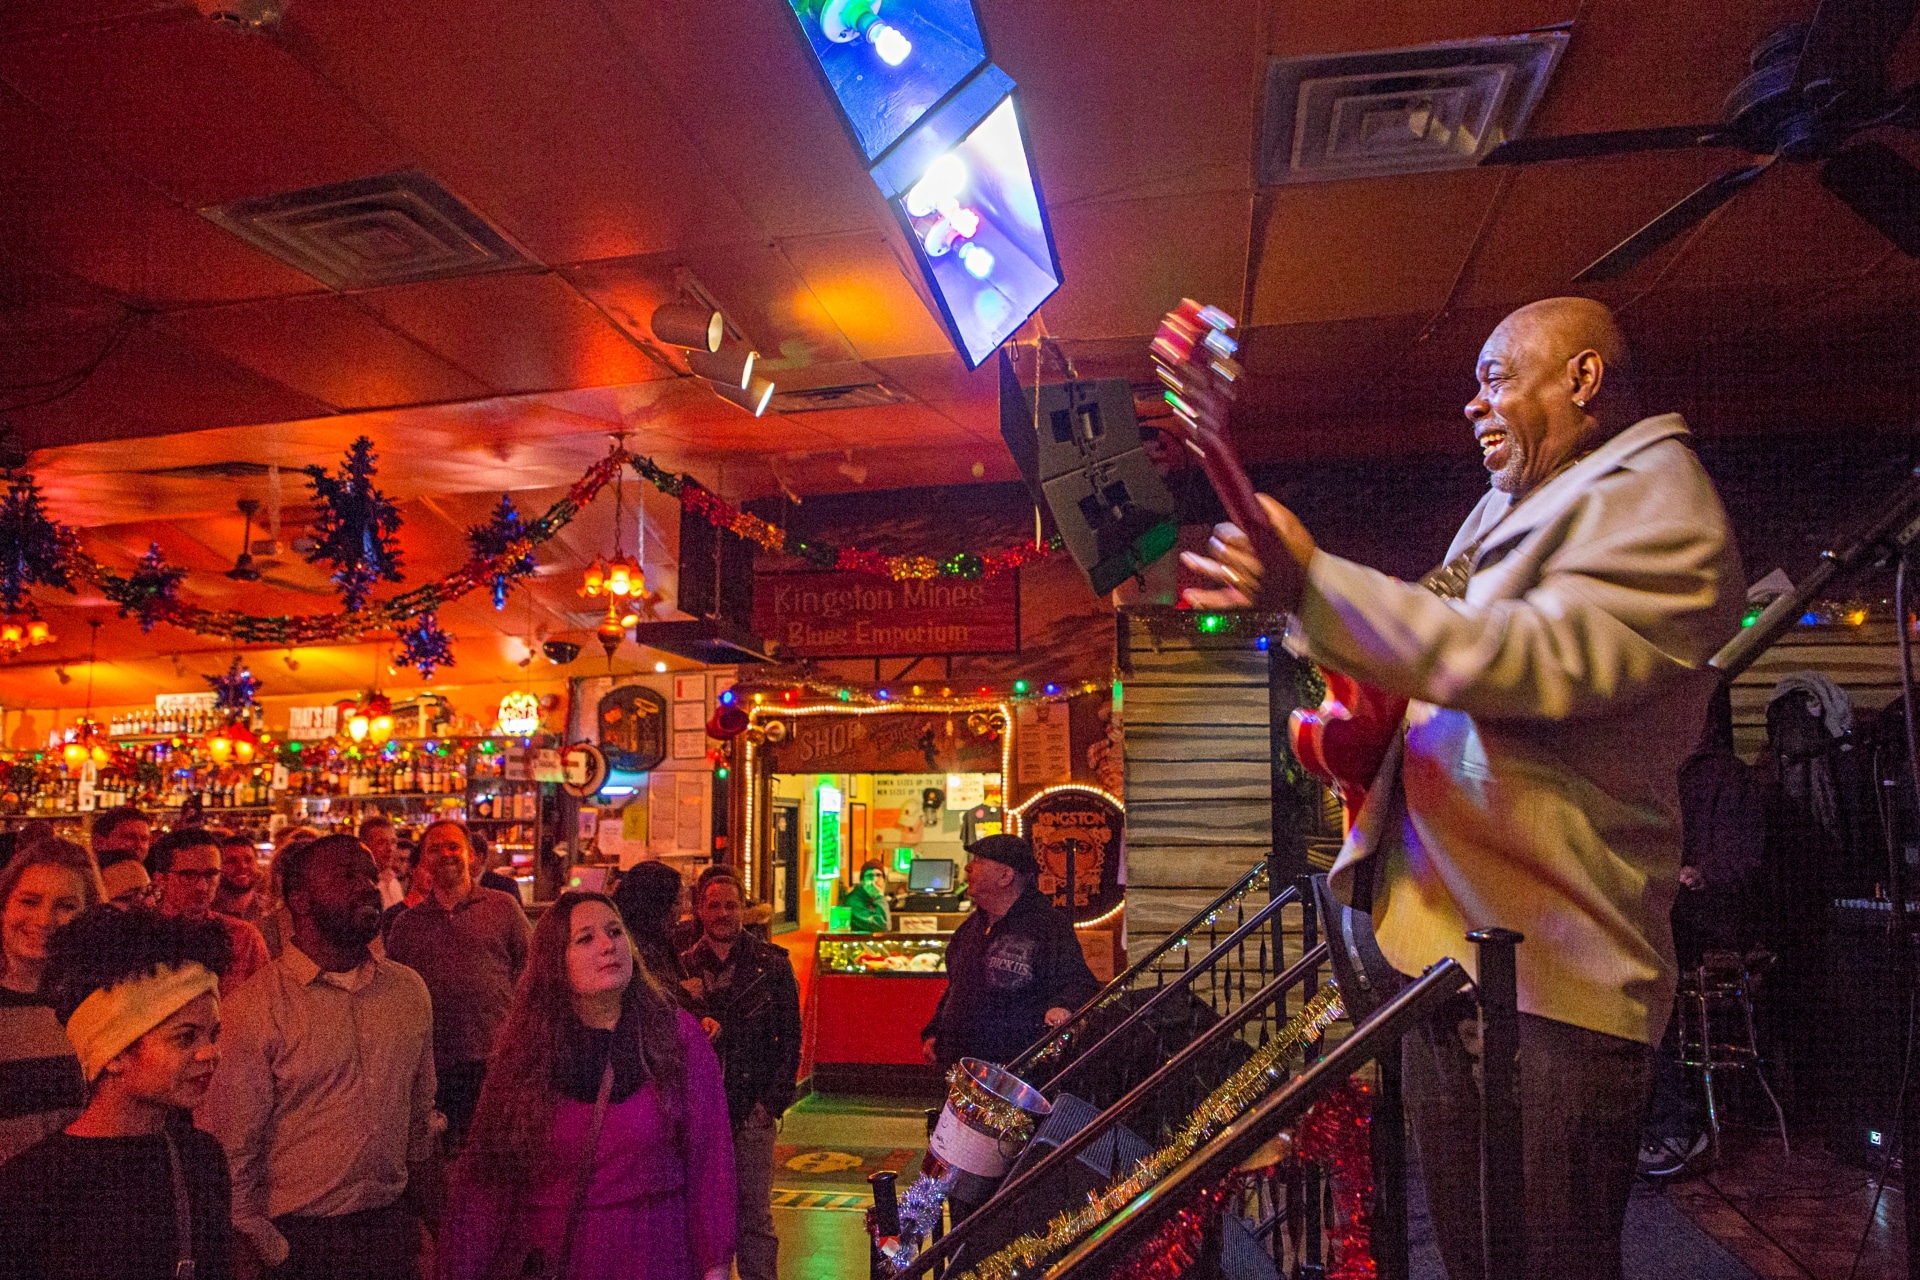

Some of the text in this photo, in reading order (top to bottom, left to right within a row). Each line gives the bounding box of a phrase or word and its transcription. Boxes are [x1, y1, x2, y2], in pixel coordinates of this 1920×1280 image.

[774, 579, 985, 616] Kingston Mines
[787, 620, 969, 647] Blues Emporium
[800, 721, 861, 762] SHOP
[1038, 812, 1106, 827] KINGSTON
